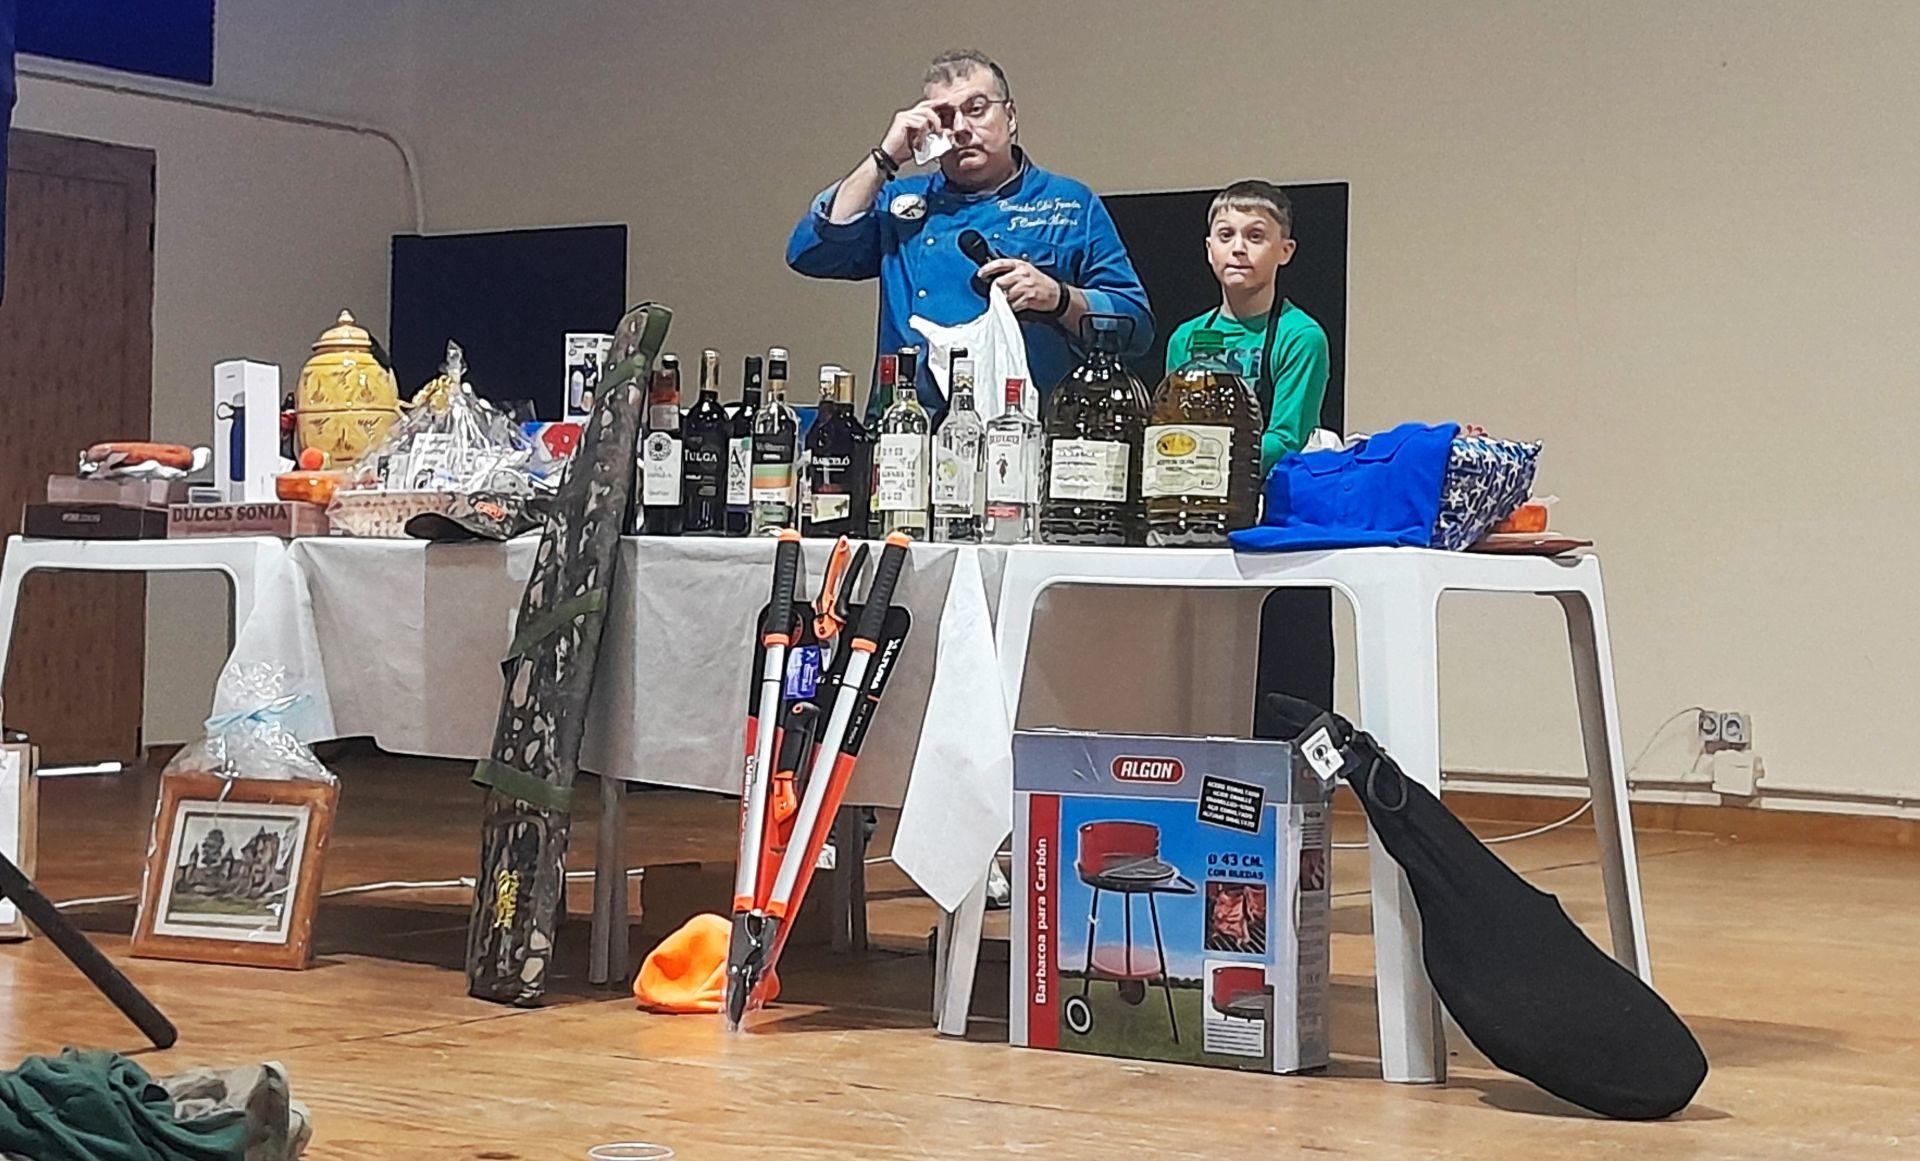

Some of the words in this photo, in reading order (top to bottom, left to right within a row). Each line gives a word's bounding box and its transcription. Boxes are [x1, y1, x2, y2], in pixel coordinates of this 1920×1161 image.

[684, 448, 718, 462] TULGA
[172, 506, 233, 523] DULCES
[236, 505, 287, 521] SONIA
[1120, 761, 1174, 779] ALGON
[1035, 838, 1047, 892] Carbón
[1221, 853, 1238, 866] 43
[1207, 868, 1226, 877] CON
[1037, 896, 1049, 930] para
[1035, 933, 1047, 1004] Barbacoa
